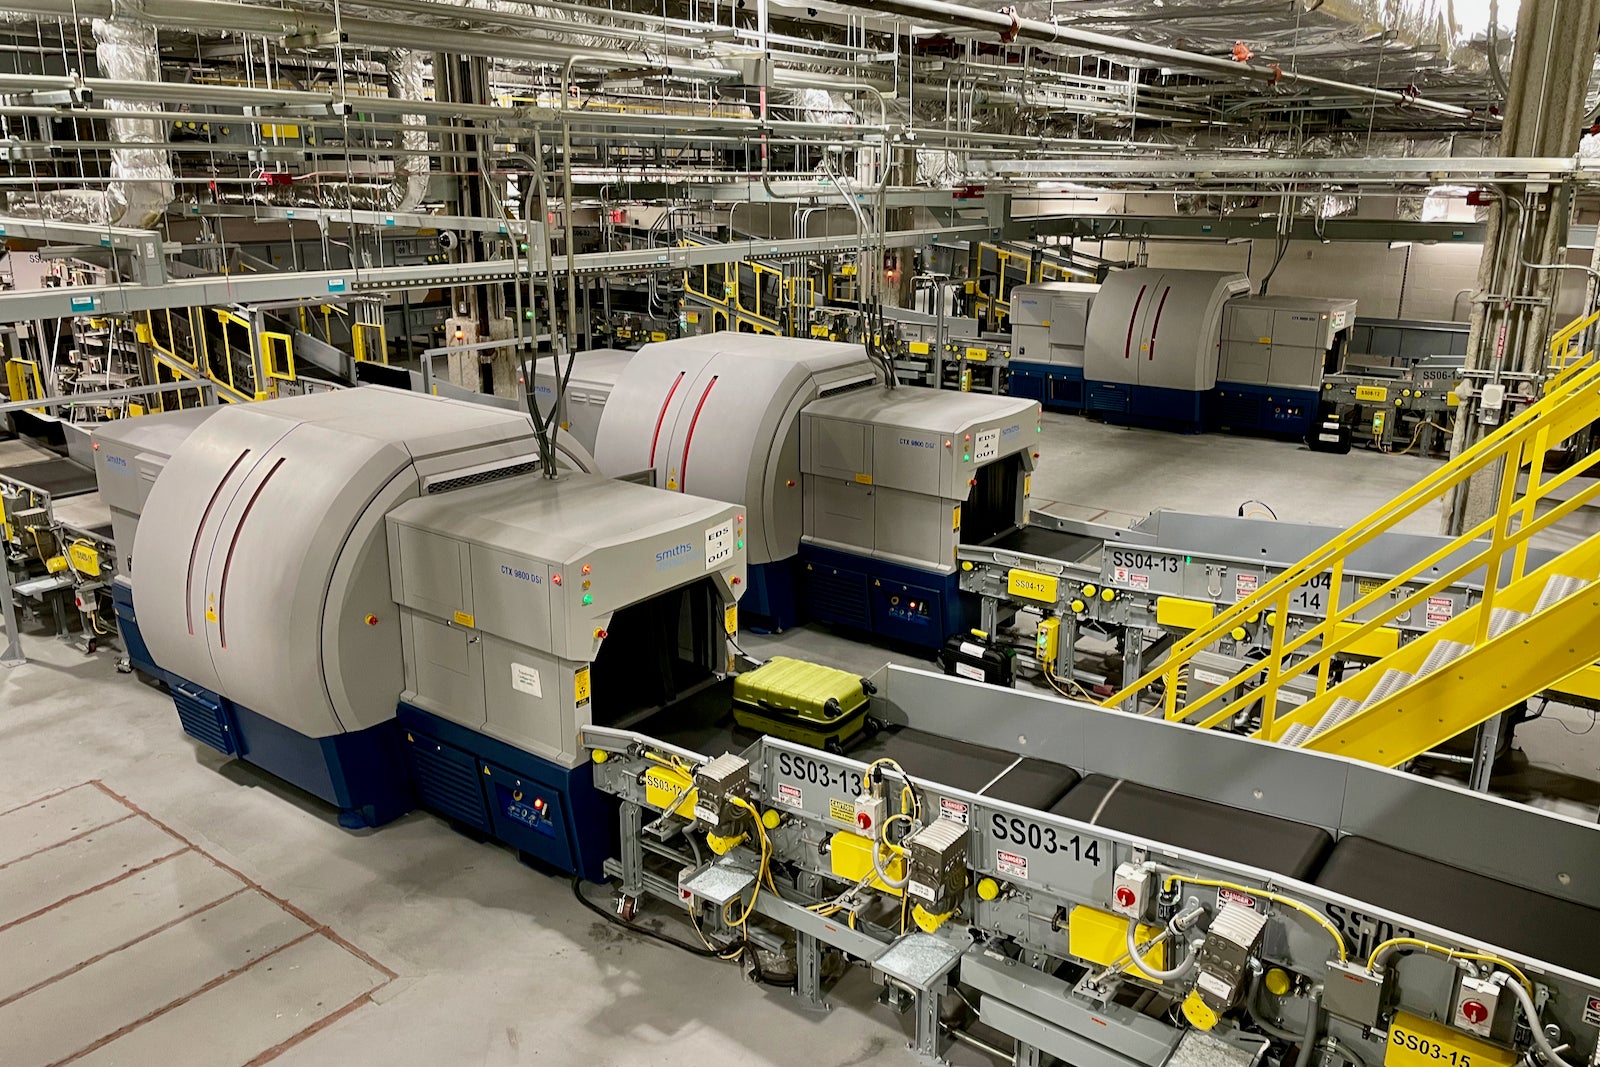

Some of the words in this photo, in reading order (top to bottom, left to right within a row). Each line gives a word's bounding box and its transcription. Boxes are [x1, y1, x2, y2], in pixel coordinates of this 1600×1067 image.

[978, 433, 996, 442] EDS
[976, 450, 995, 459] OUT
[708, 526, 730, 541] EDS
[656, 543, 692, 562] smiths
[708, 548, 730, 563] OUT
[1113, 551, 1178, 572] SS04-13
[501, 565, 513, 576] CTX
[514, 568, 530, 581] 9800
[1015, 579, 1045, 592] SS04-12
[1293, 592, 1321, 609] -14
[779, 752, 862, 796] SS03-13
[647, 775, 683, 796] SS03-12
[831, 799, 855, 812] CAUTION
[992, 813, 1101, 867] SS03-14
[999, 852, 1026, 866] DANGER
[1225, 890, 1251, 905] DANGER
[1393, 1030, 1471, 1067] SS03-15
